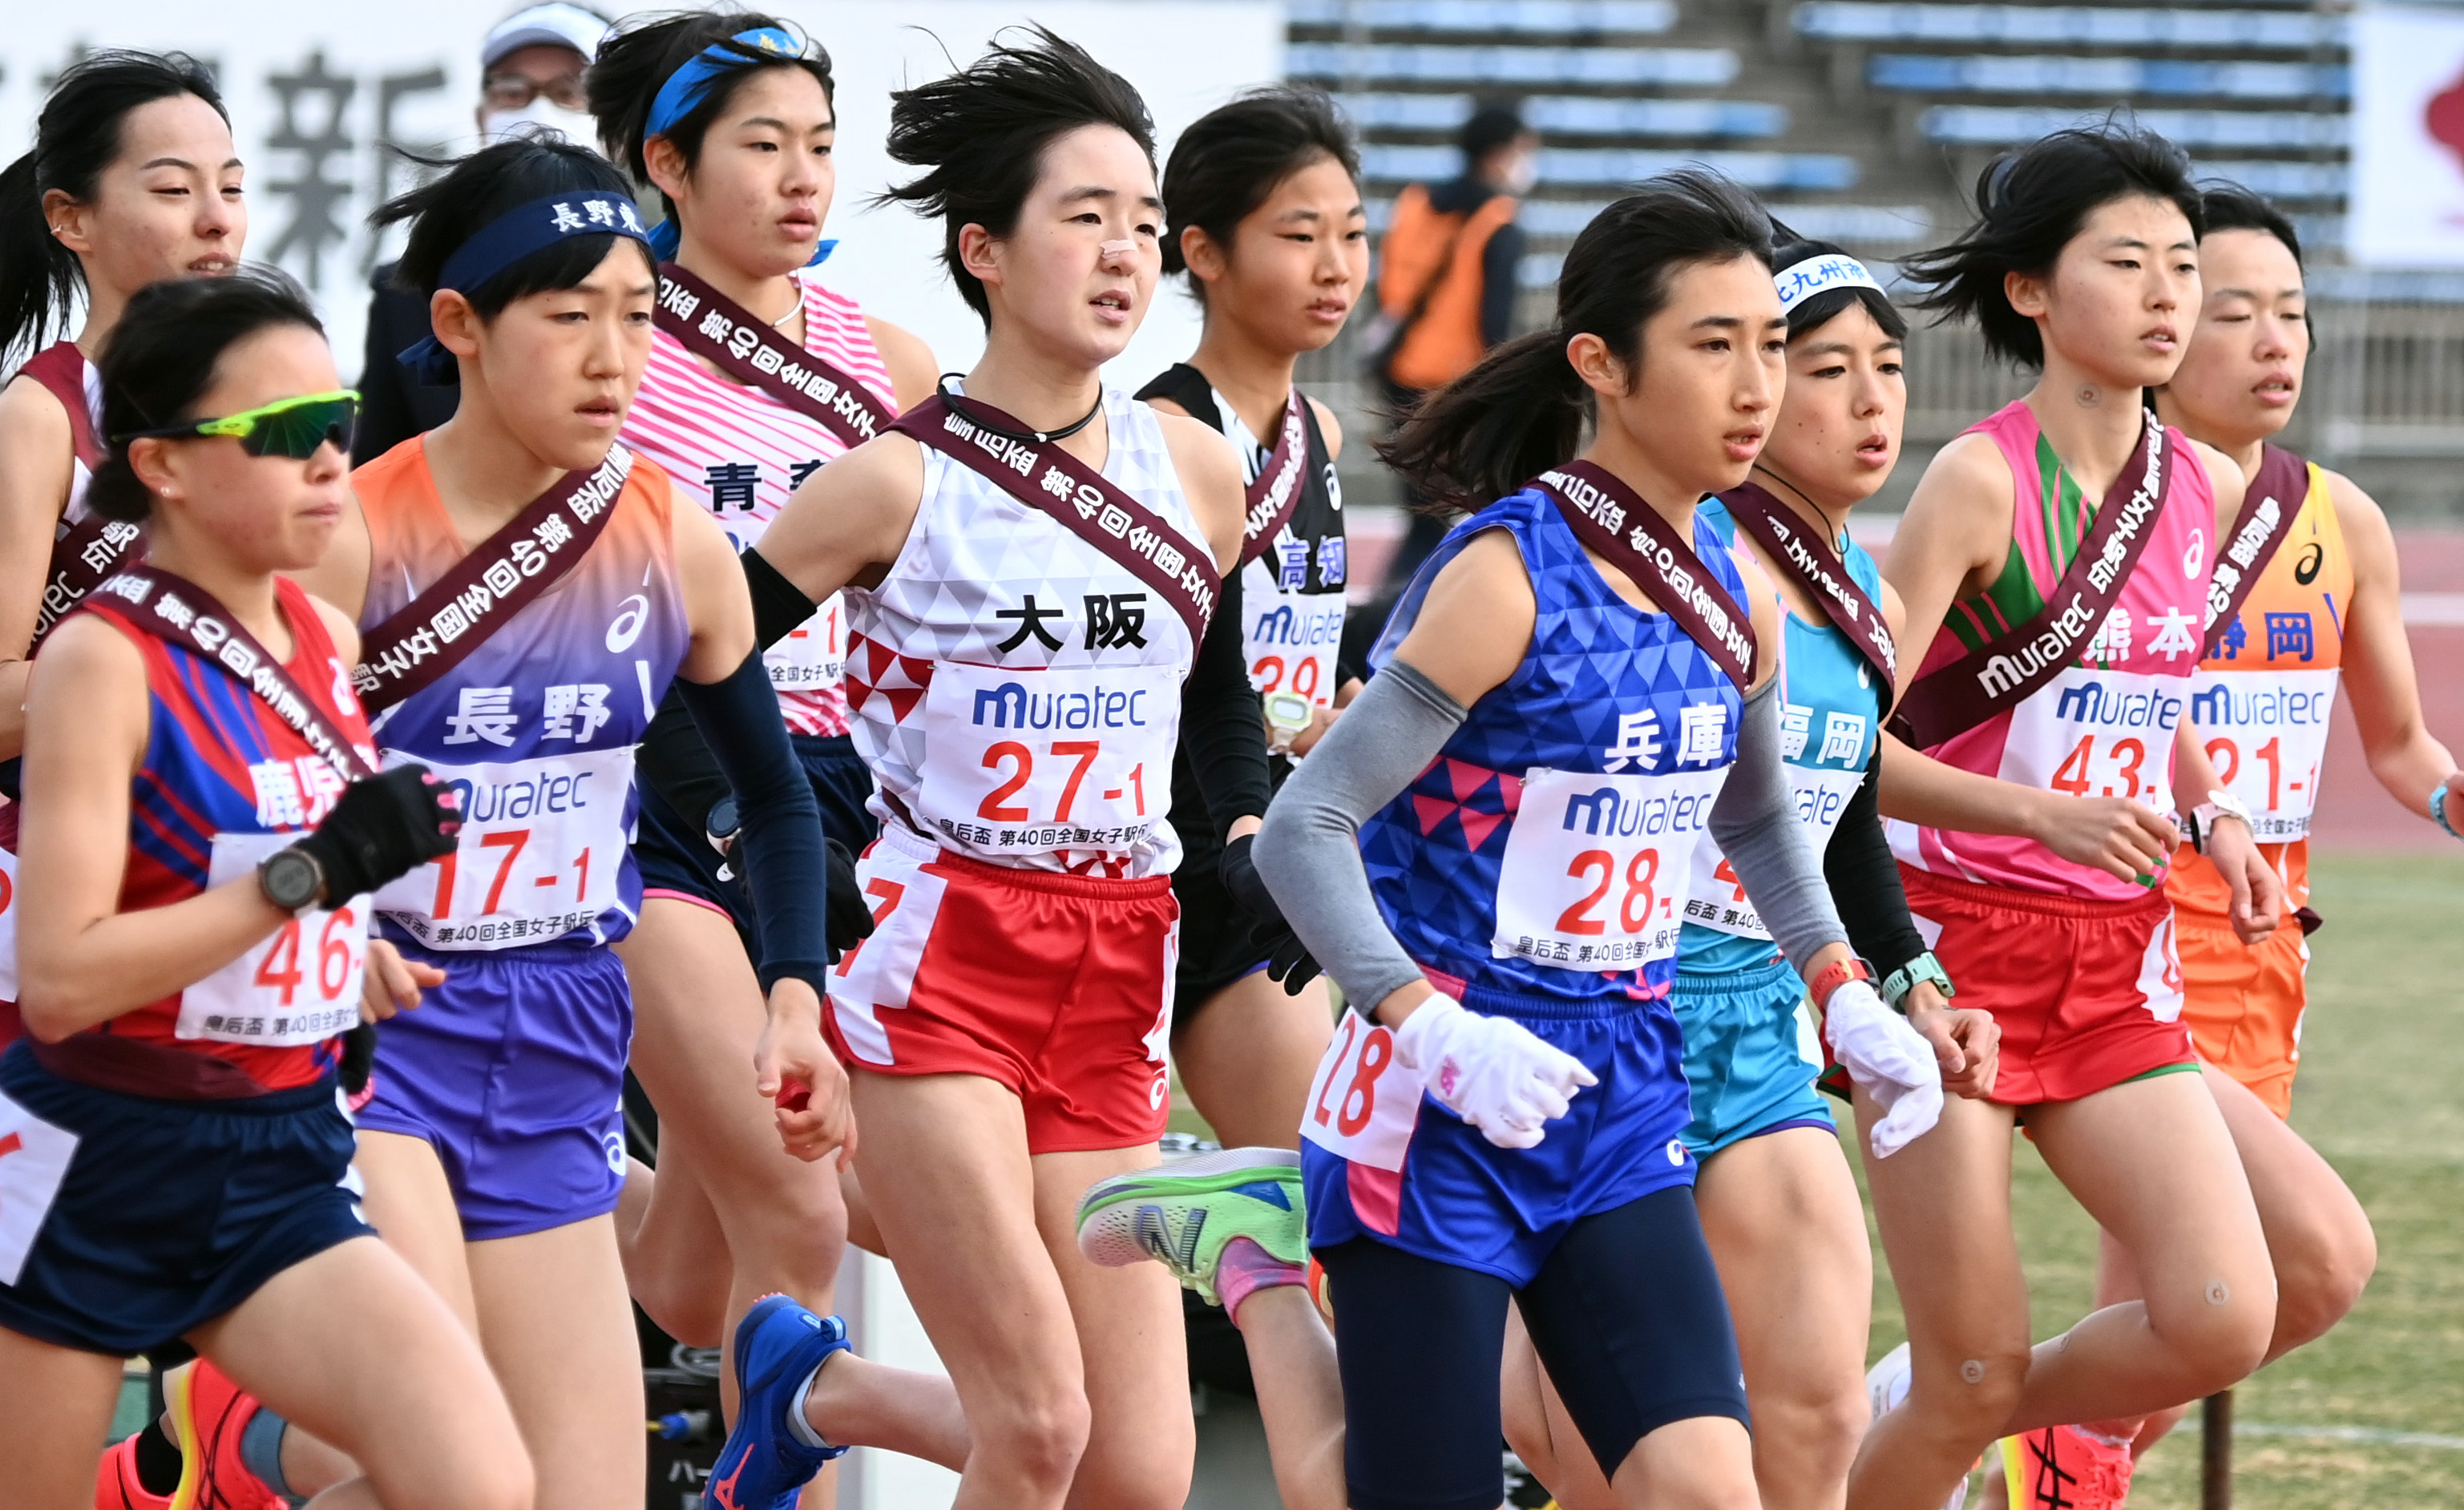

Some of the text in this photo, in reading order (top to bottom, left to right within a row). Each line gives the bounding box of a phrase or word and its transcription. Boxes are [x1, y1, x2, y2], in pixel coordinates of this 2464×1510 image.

[551, 200, 643, 232] 長野東
[943, 411, 1038, 477] 皇后盃
[568, 442, 633, 525] 皇后盃
[1538, 470, 1627, 535] 皇后盃
[2086, 414, 2164, 594] 回全国女子駅伝
[80, 520, 139, 575] 駅伝
[1278, 537, 1346, 590] 高知
[996, 592, 1148, 654] 大阪
[2082, 606, 2198, 663] 熊本
[442, 684, 612, 748] 長野
[1602, 702, 1727, 774] 兵庫
[248, 757, 353, 828] 鹿児
[976, 740, 1145, 823] 27-1
[939, 818, 992, 846] 皇后盃
[385, 910, 596, 943] 后盃 第40回全国女子駅伝
[834, 876, 906, 978] 7
[1683, 898, 1719, 921] 后盃
[1514, 935, 1572, 961] 皇后盃
